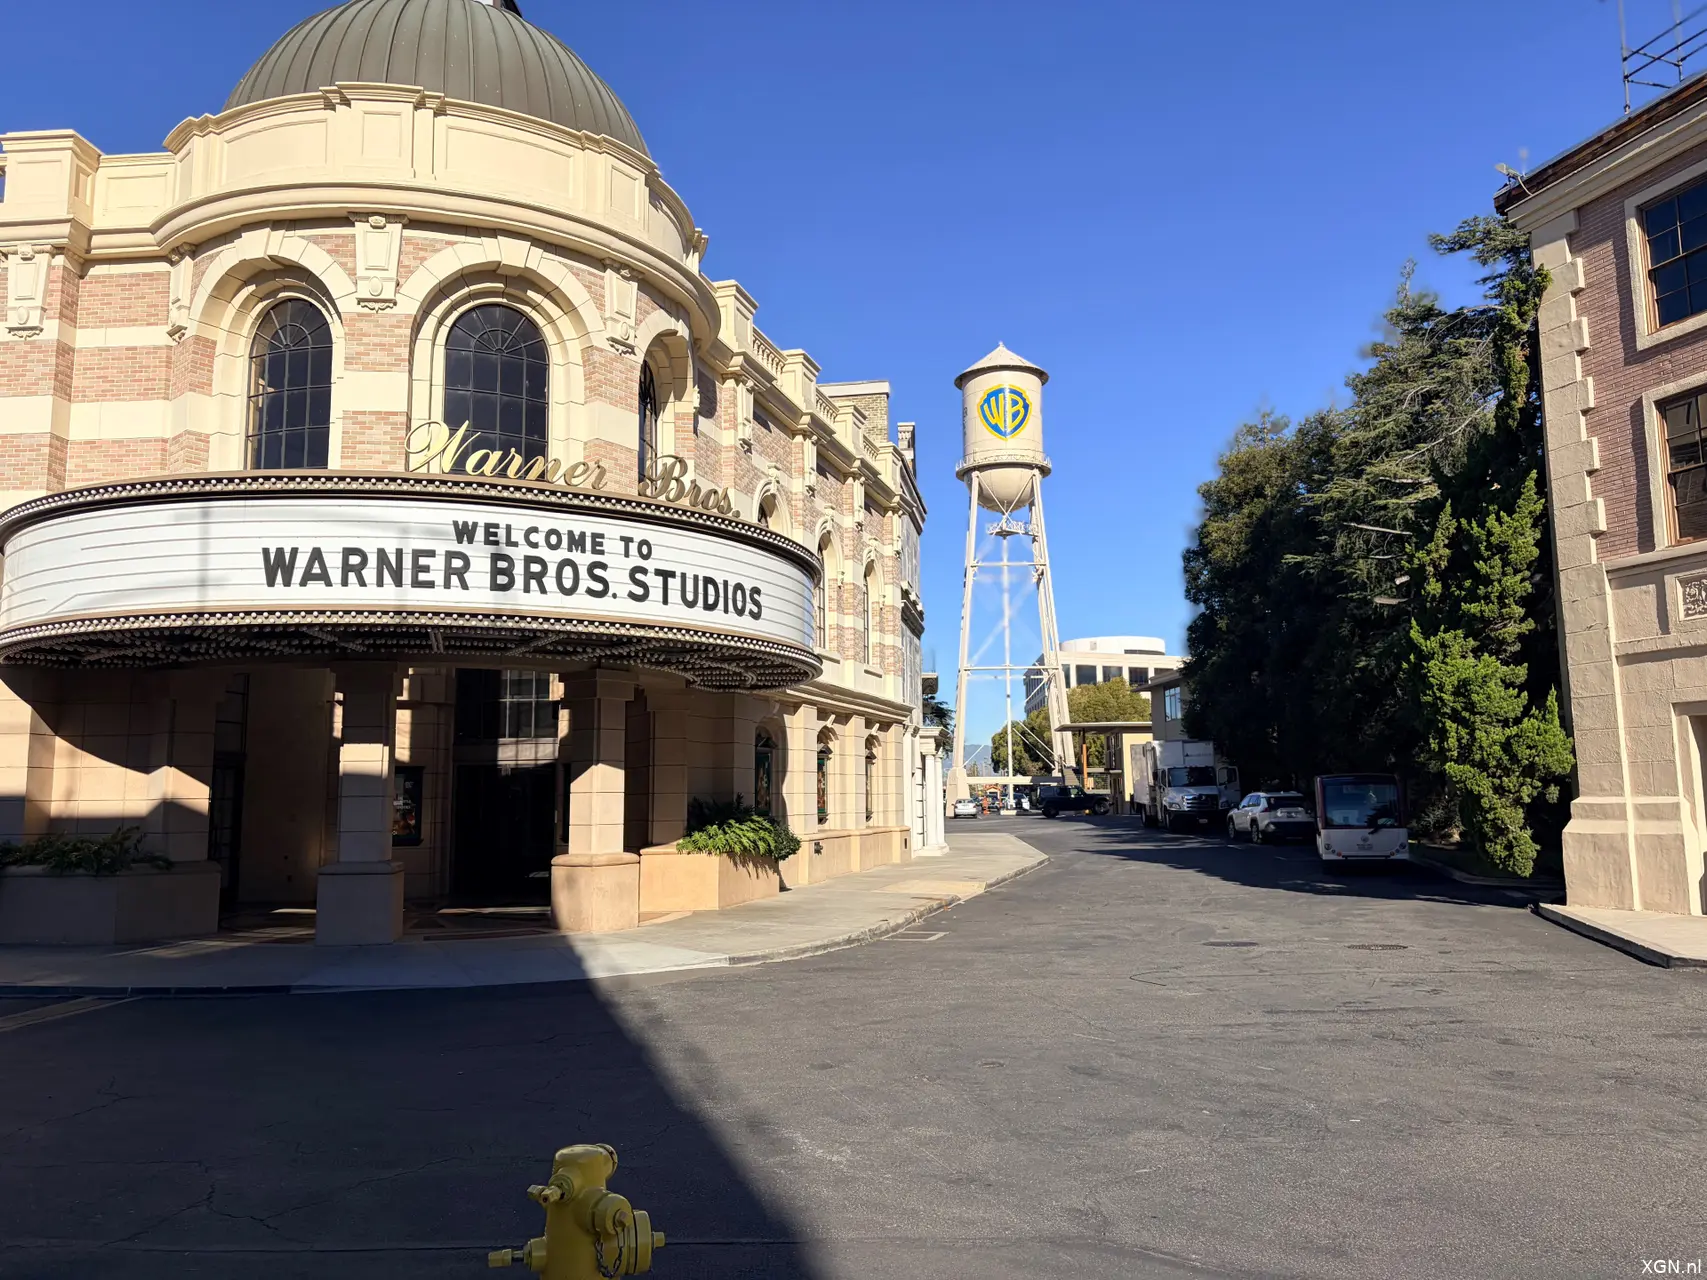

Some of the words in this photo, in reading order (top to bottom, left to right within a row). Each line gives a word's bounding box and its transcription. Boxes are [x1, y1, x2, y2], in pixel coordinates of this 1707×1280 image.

[982, 391, 1026, 434] WB
[404, 419, 608, 490] Warner
[638, 454, 741, 518] Bros.
[452, 520, 606, 555] WELCOME
[619, 535, 653, 560] TO
[261, 546, 471, 590] WARNER
[489, 552, 618, 599] BROS.
[627, 566, 763, 620] STUDIOS
